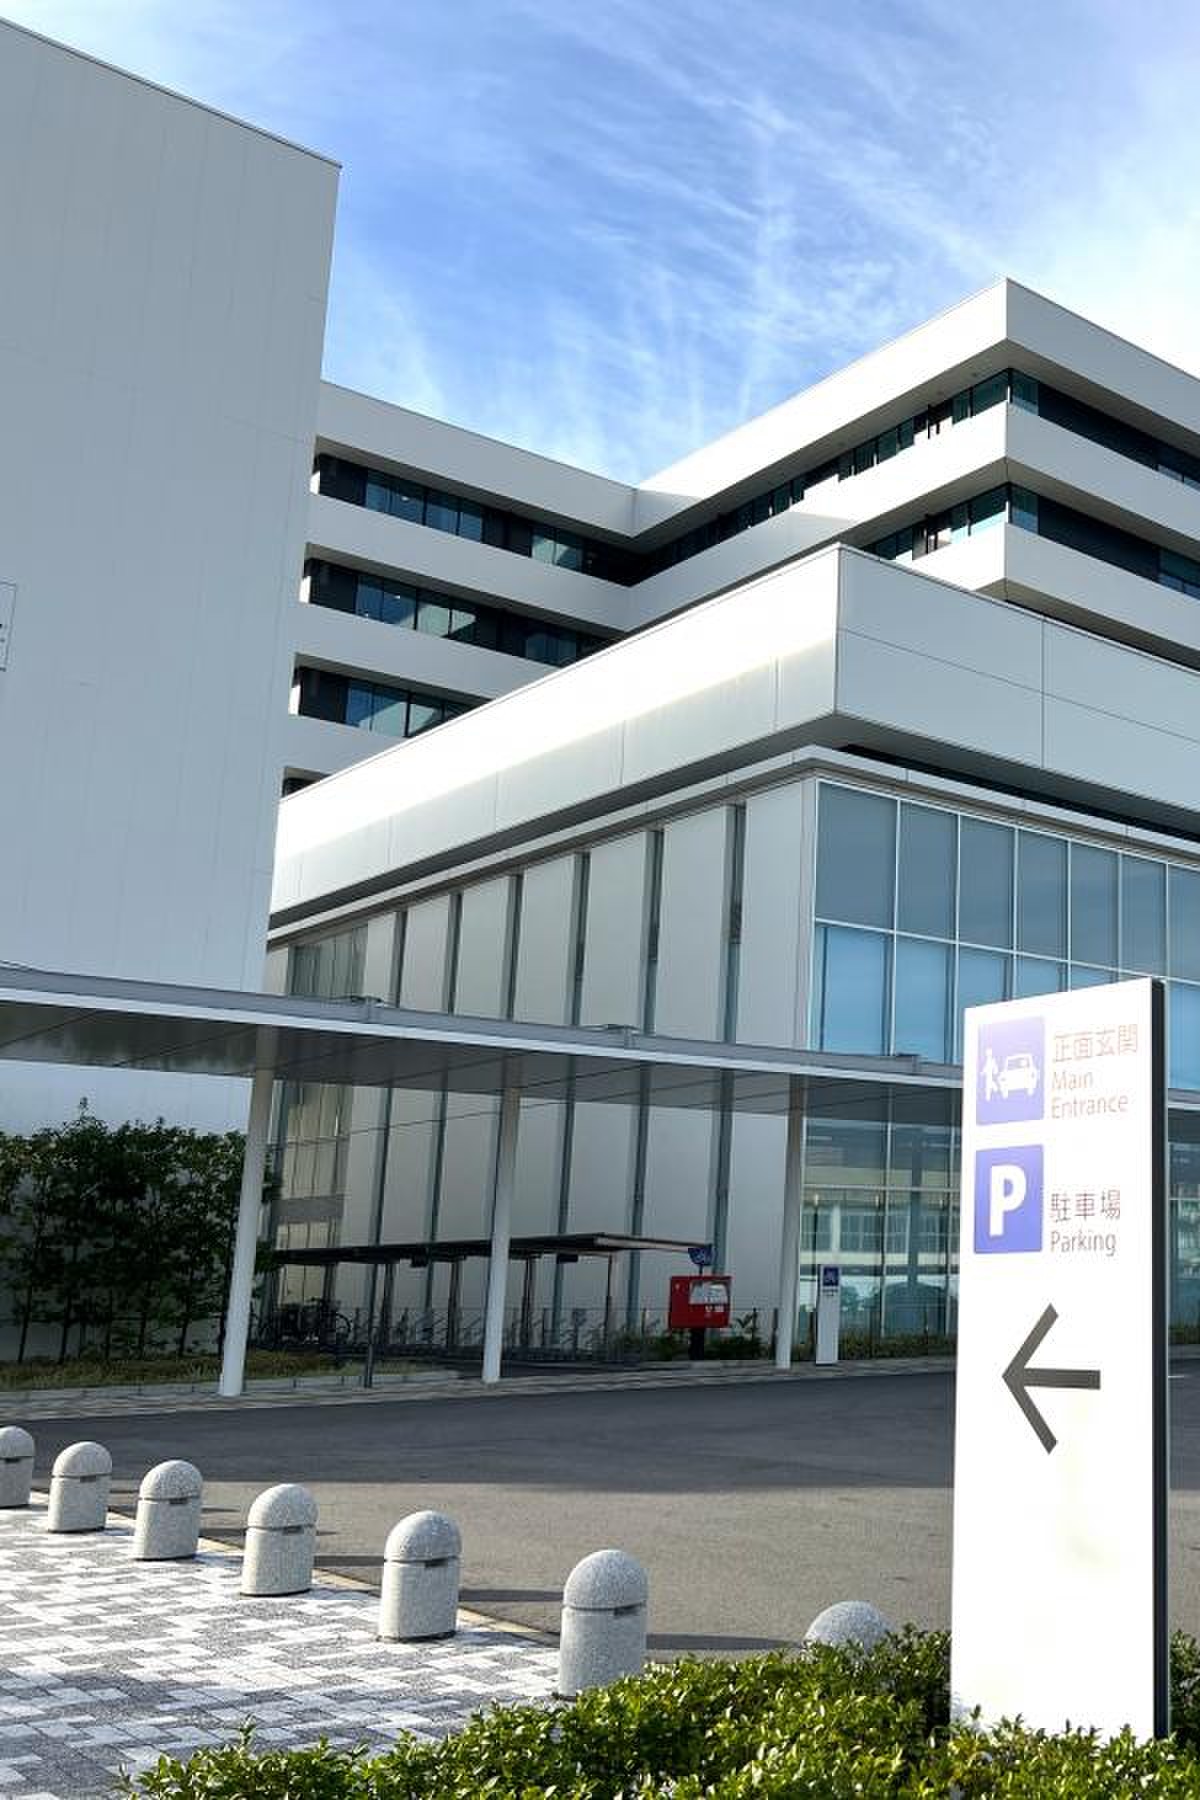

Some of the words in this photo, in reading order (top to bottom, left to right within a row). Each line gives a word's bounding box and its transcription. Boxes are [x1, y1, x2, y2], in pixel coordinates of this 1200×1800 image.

[1052, 1024, 1138, 1062] 正面玄関
[1052, 1070, 1094, 1091] Main
[1051, 1095, 1129, 1119] Entrance
[989, 1164, 1027, 1238] P
[1050, 1189, 1121, 1222] 駐車場
[1050, 1229, 1117, 1257] Parking
